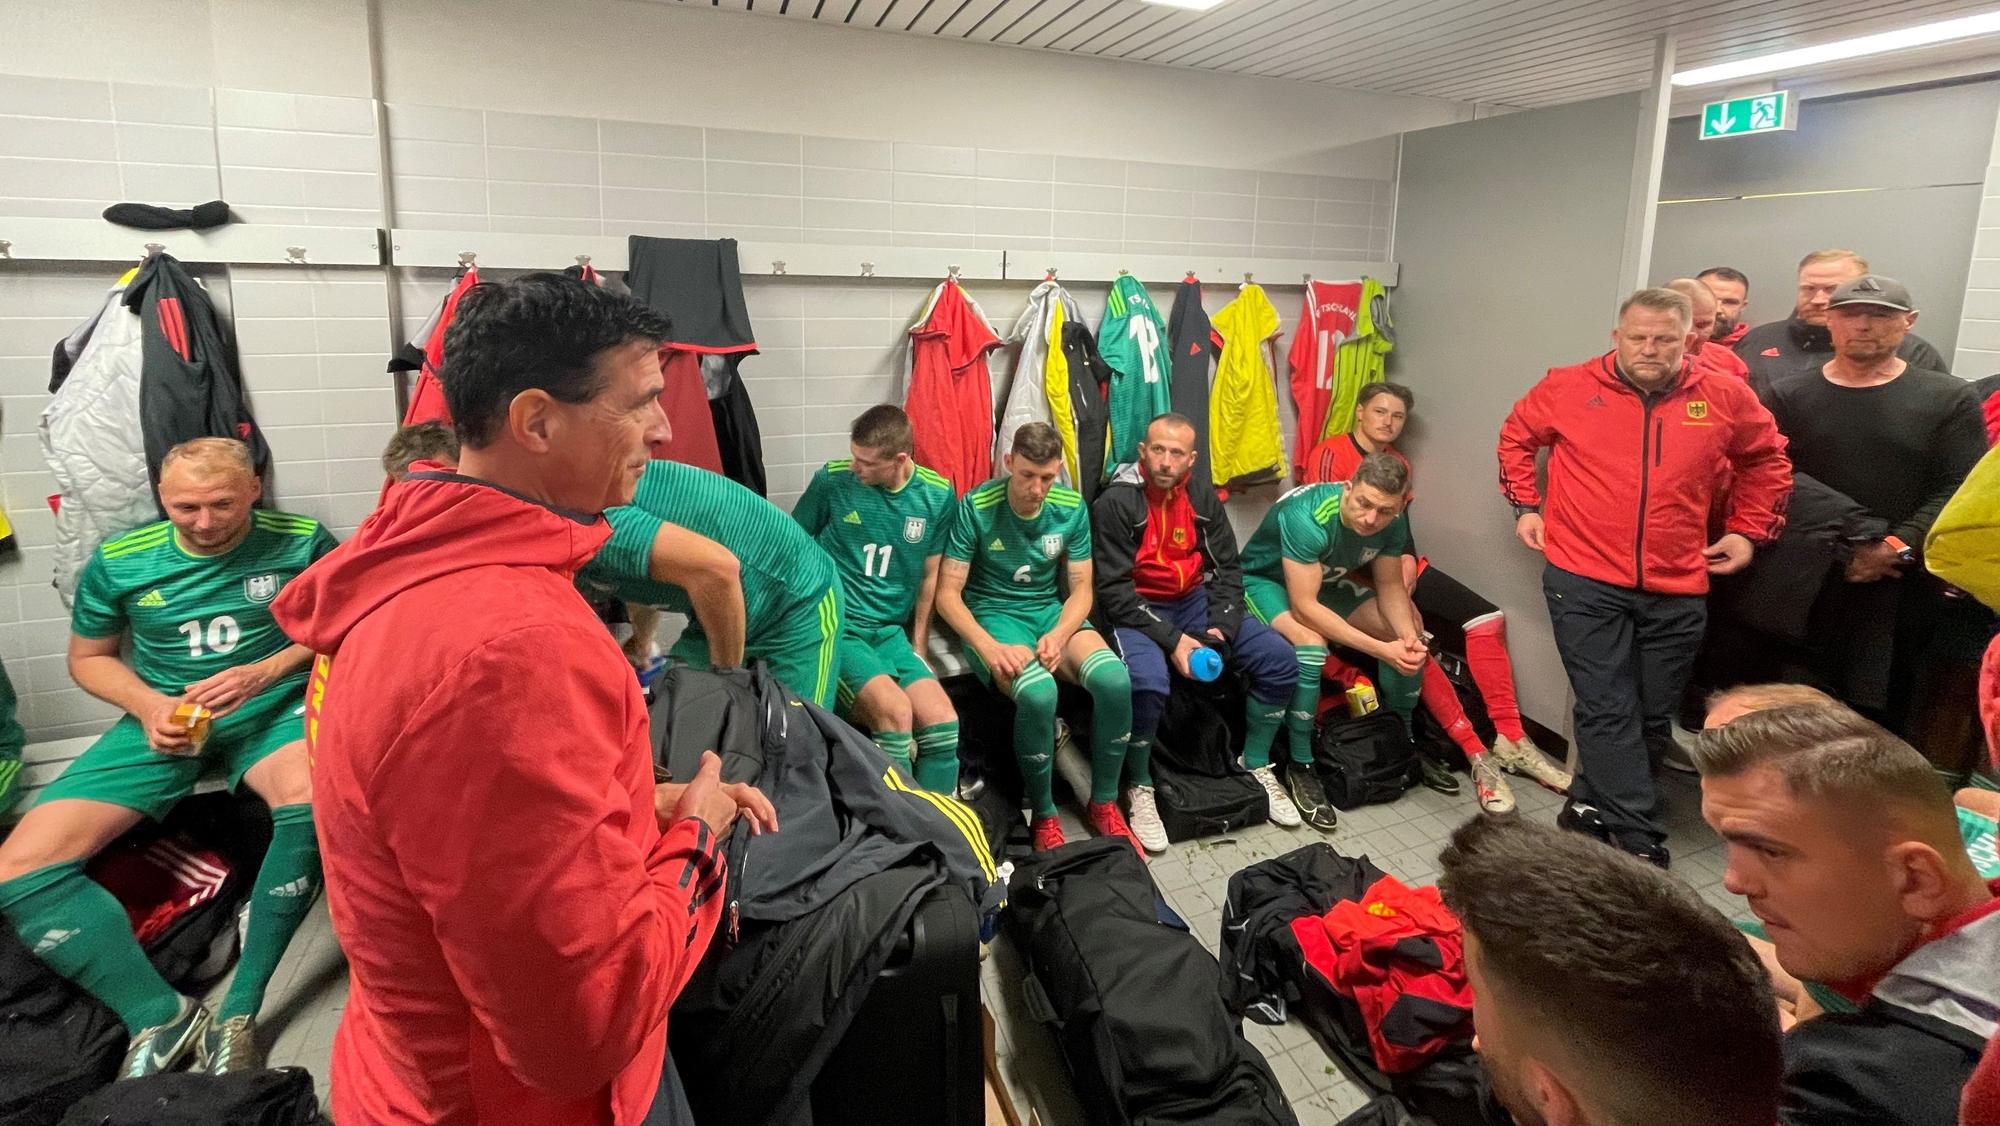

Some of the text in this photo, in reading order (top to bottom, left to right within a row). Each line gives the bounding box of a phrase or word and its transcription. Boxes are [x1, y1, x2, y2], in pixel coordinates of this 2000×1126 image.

[863, 543, 892, 577] 11
[1013, 565, 1032, 582] 6
[178, 615, 240, 657] 10
